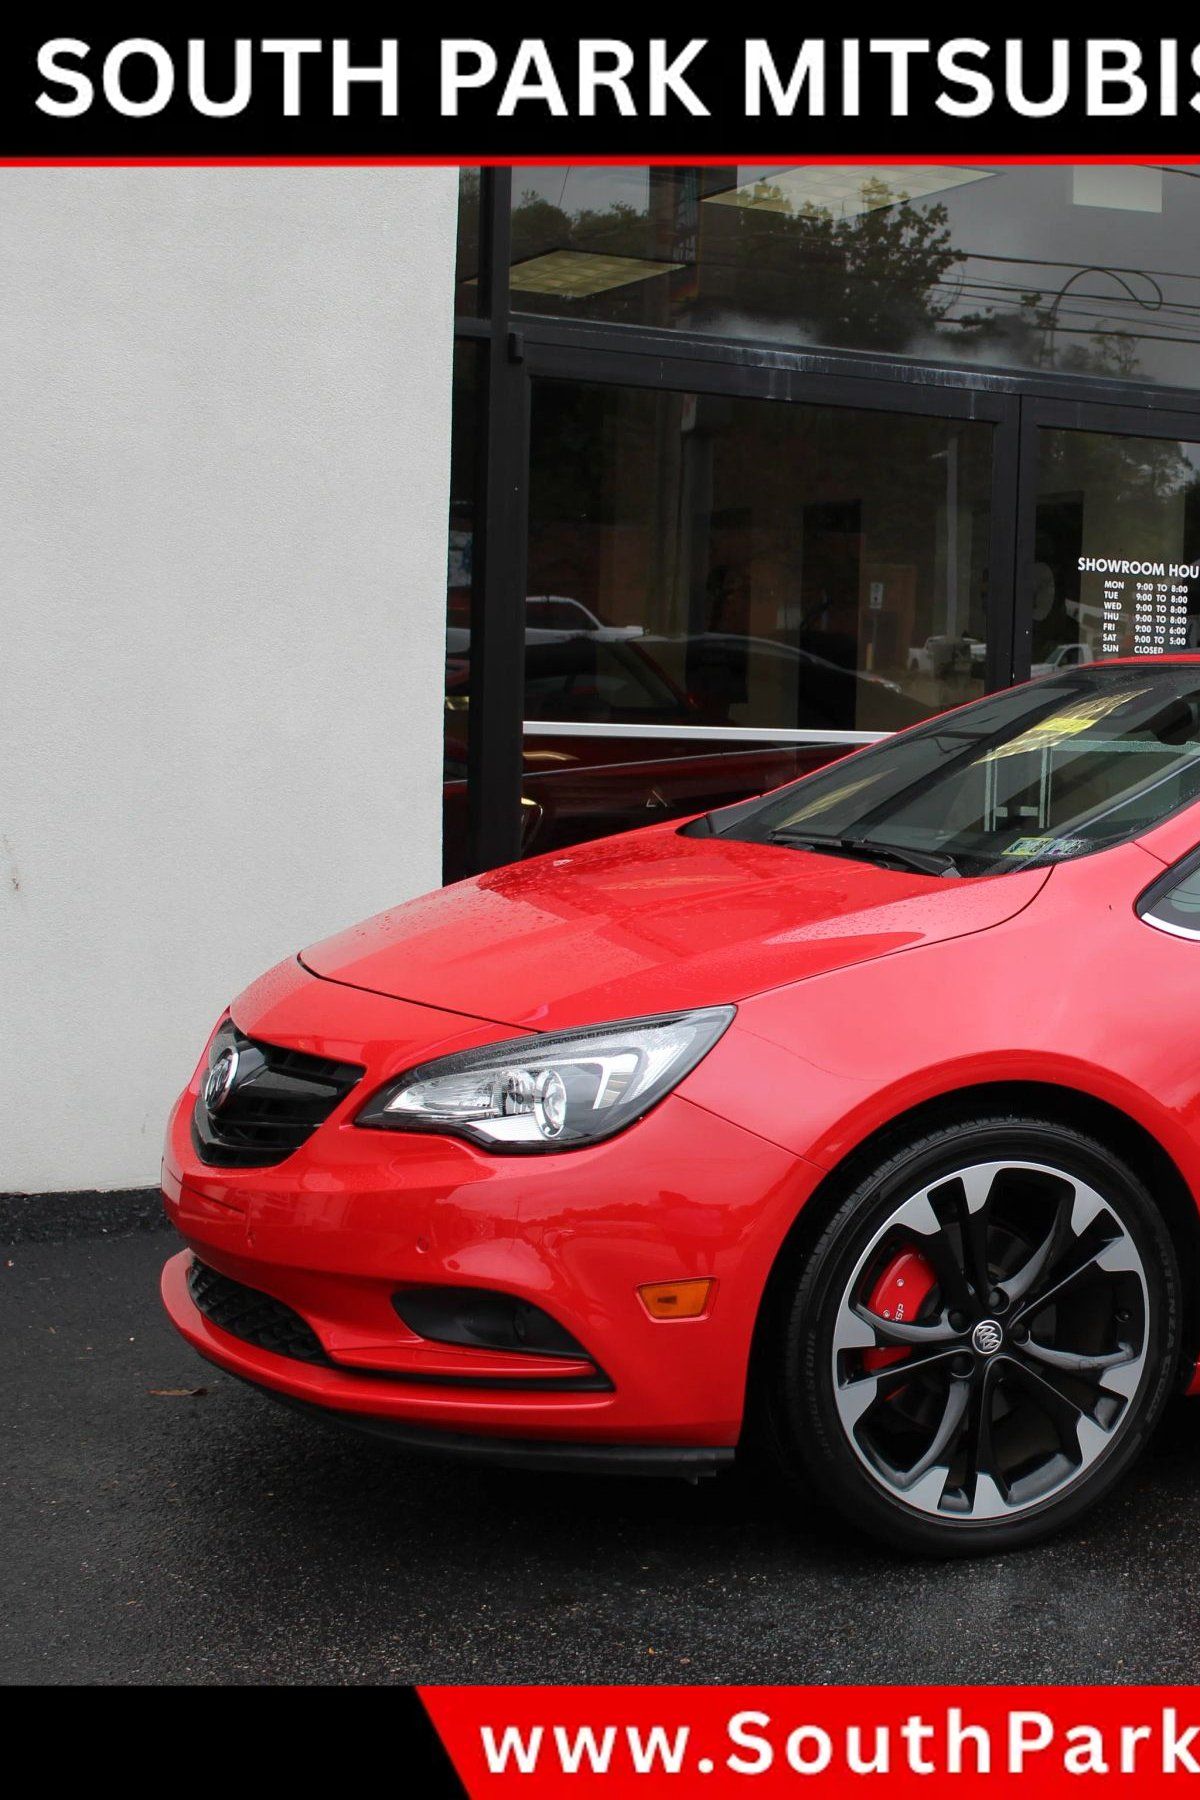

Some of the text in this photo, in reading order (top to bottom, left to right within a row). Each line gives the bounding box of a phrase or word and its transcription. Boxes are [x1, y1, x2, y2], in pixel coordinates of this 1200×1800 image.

[1077, 557, 1165, 576] SHOWROOM
[1104, 580, 1188, 593] MON 9:00 TO 8:00
[1104, 591, 1188, 604] TUE 9:00 TO 8:00
[1104, 602, 1187, 614] WED 9:00 TO 8:00
[1103, 612, 1187, 625] THU 9:00 TO 8:00
[1103, 623, 1186, 635] FRI 9:00 TO 6:00
[1102, 633, 1186, 646] SAT 9:00 TO 5:00
[1102, 644, 1164, 655] SUN CLOSED
